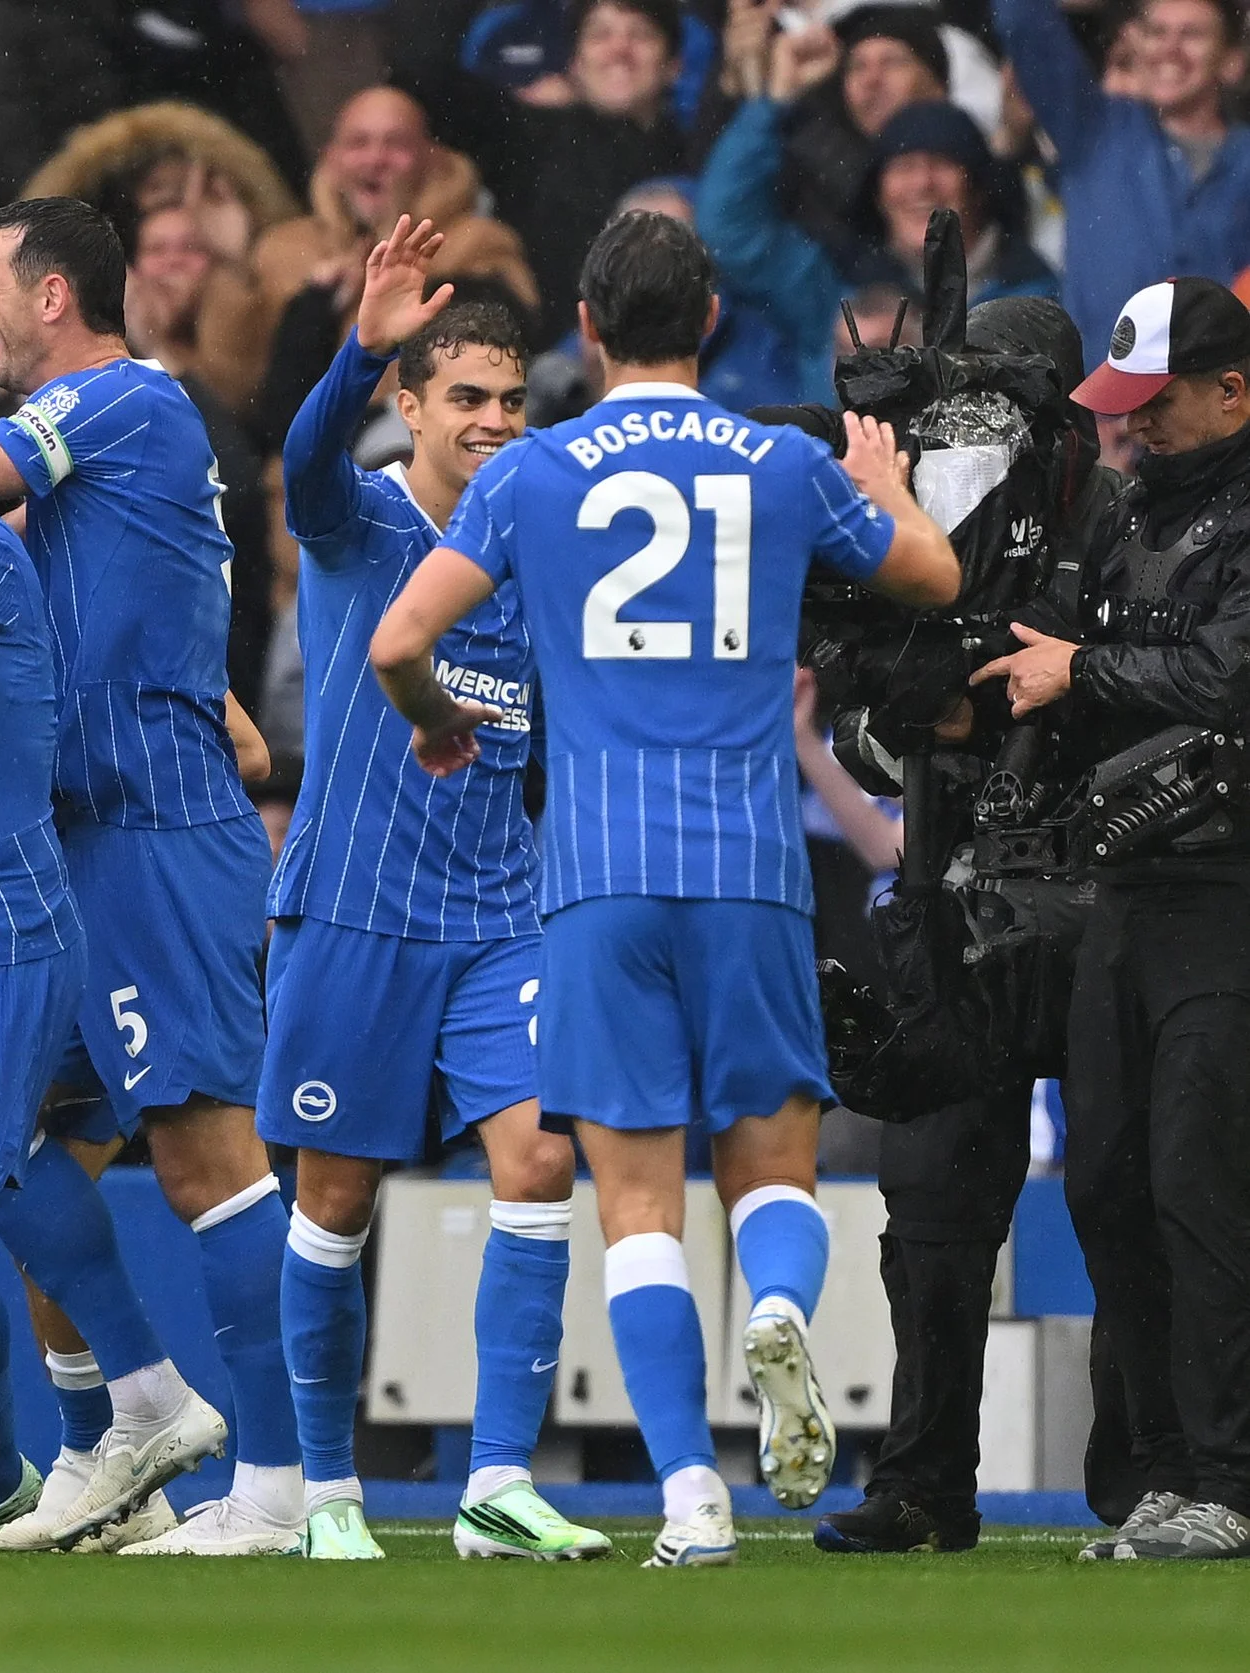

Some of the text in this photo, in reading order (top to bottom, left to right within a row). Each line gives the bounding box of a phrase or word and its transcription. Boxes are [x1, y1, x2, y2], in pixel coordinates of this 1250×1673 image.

[17, 409, 56, 452] ptain
[565, 411, 774, 471] BOSCAGLI
[577, 471, 752, 660] 21
[110, 985, 148, 1058] 5
